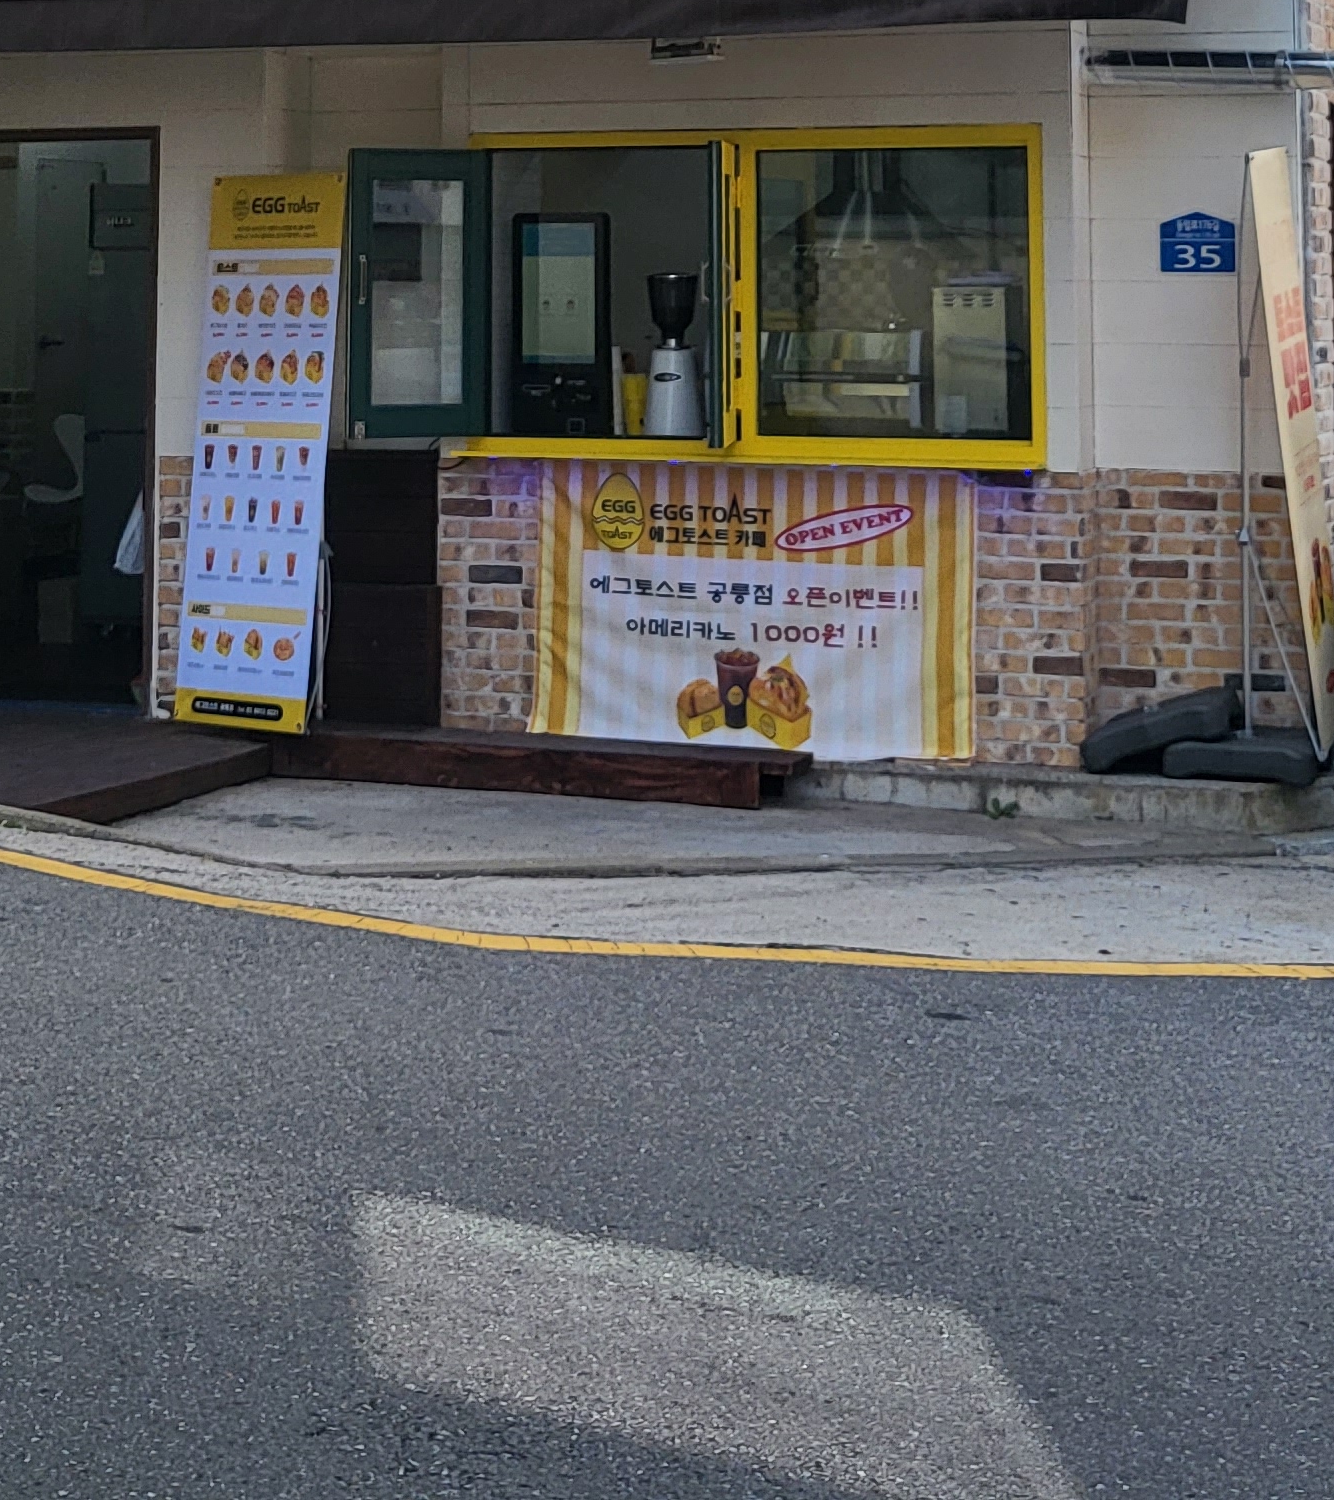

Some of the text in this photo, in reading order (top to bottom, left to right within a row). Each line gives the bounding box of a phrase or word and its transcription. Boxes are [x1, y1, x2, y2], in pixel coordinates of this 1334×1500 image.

[251, 197, 286, 213] EGG
[287, 194, 320, 213] TOAST
[1173, 244, 1221, 269] 35
[601, 499, 636, 513] EGG
[650, 493, 771, 524] EGG TOAST
[601, 526, 633, 539] TOAST
[649, 526, 766, 547] 에그토스트 카페
[785, 509, 904, 546] OPEN EVENT
[590, 575, 918, 610] 에그토스트 공릉점 오픈이벤트!!
[626, 617, 736, 641] 아메리카노
[751, 622, 844, 648] 1000원
